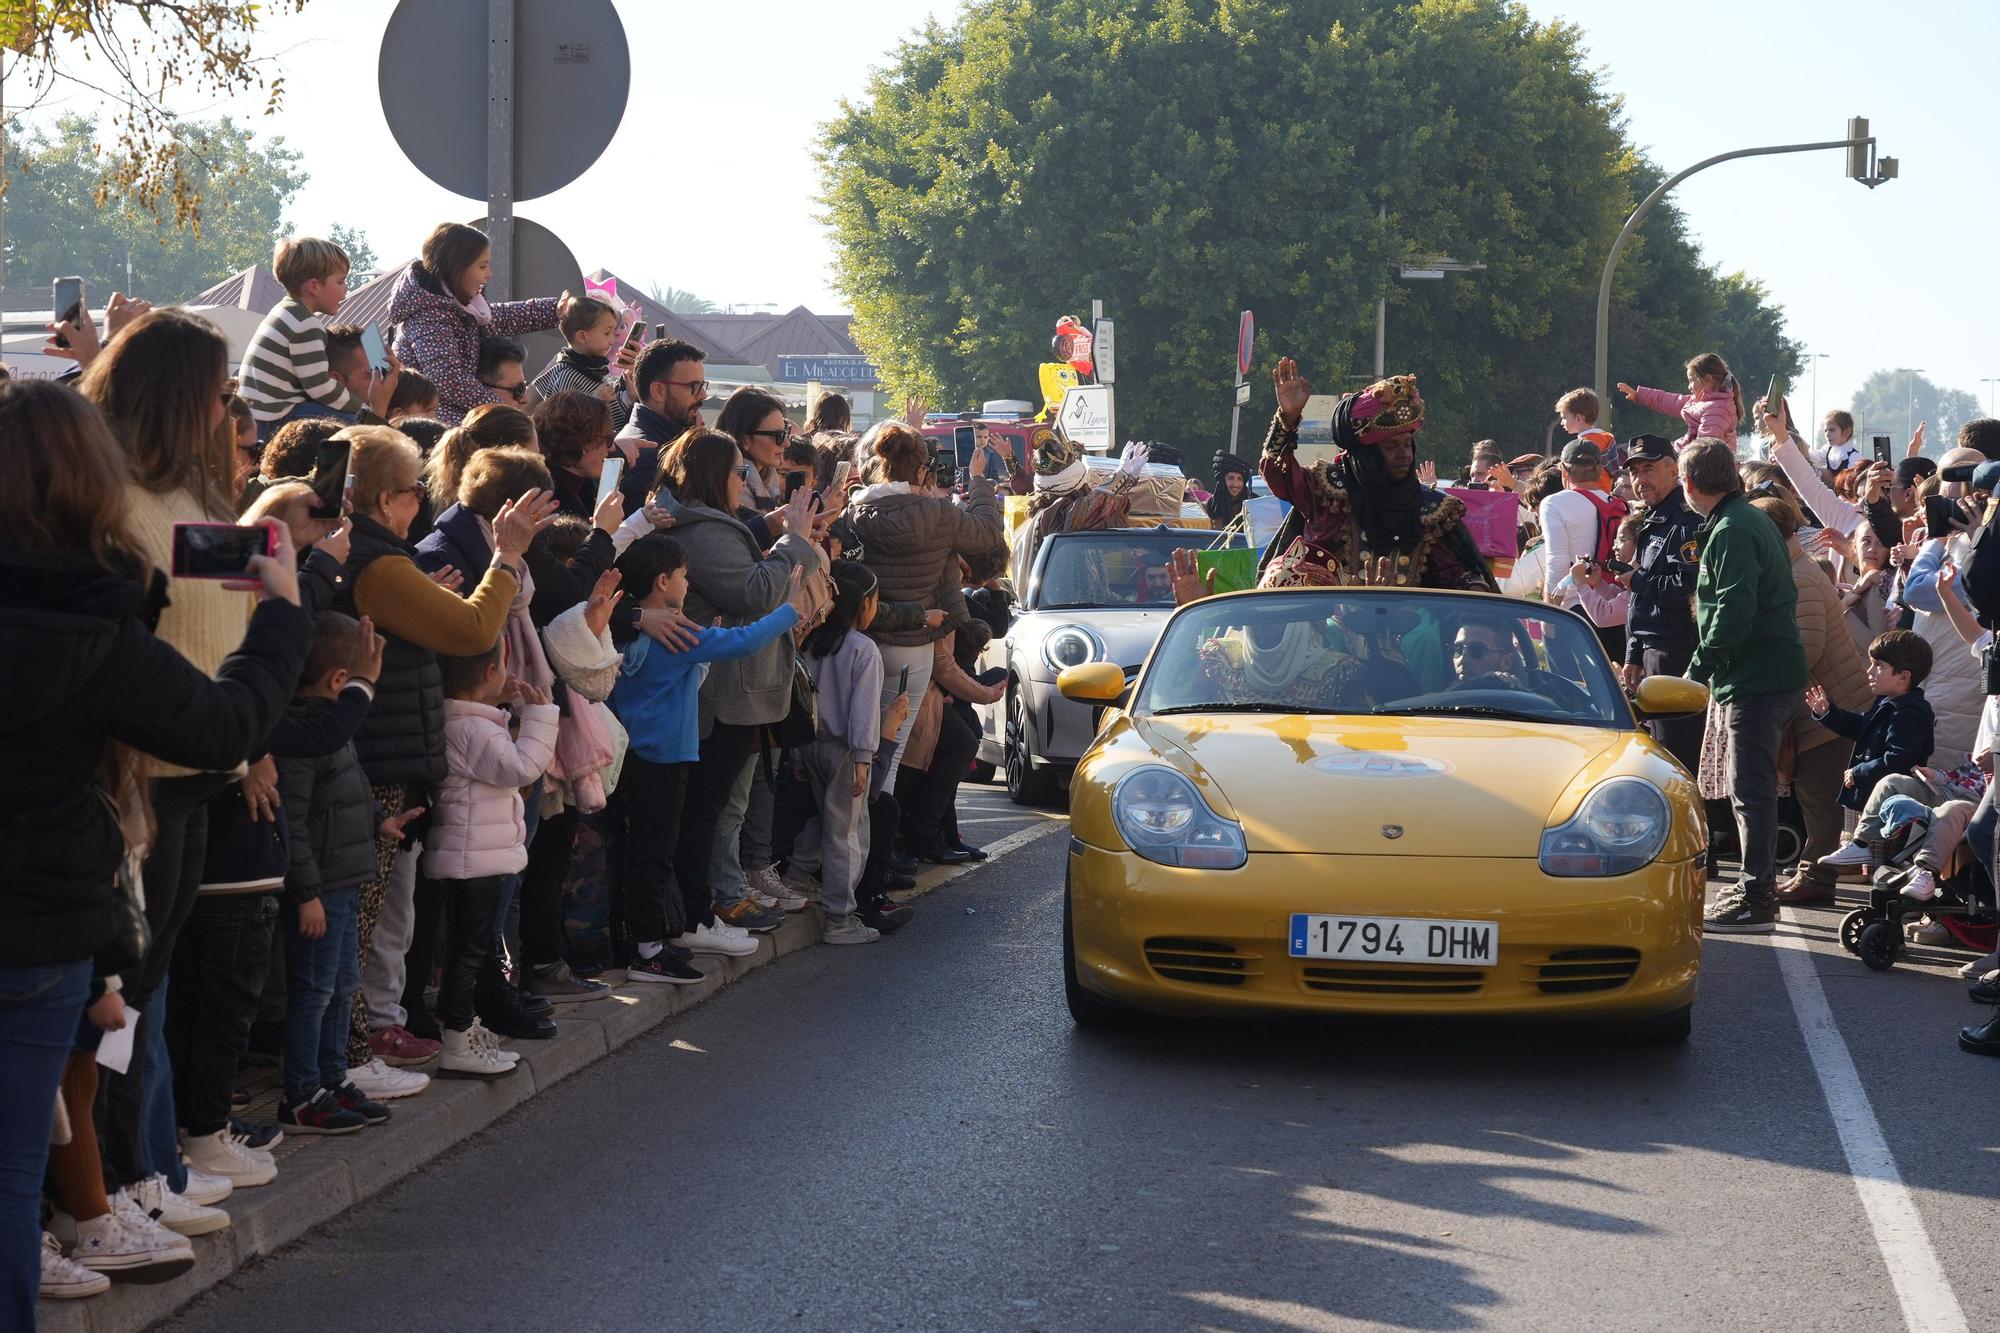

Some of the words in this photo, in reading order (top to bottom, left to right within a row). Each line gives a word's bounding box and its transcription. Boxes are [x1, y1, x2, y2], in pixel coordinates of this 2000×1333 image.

[1295, 939, 1303, 949] E
[1318, 920, 1405, 956] 1794
[1427, 925, 1490, 960] DHM
